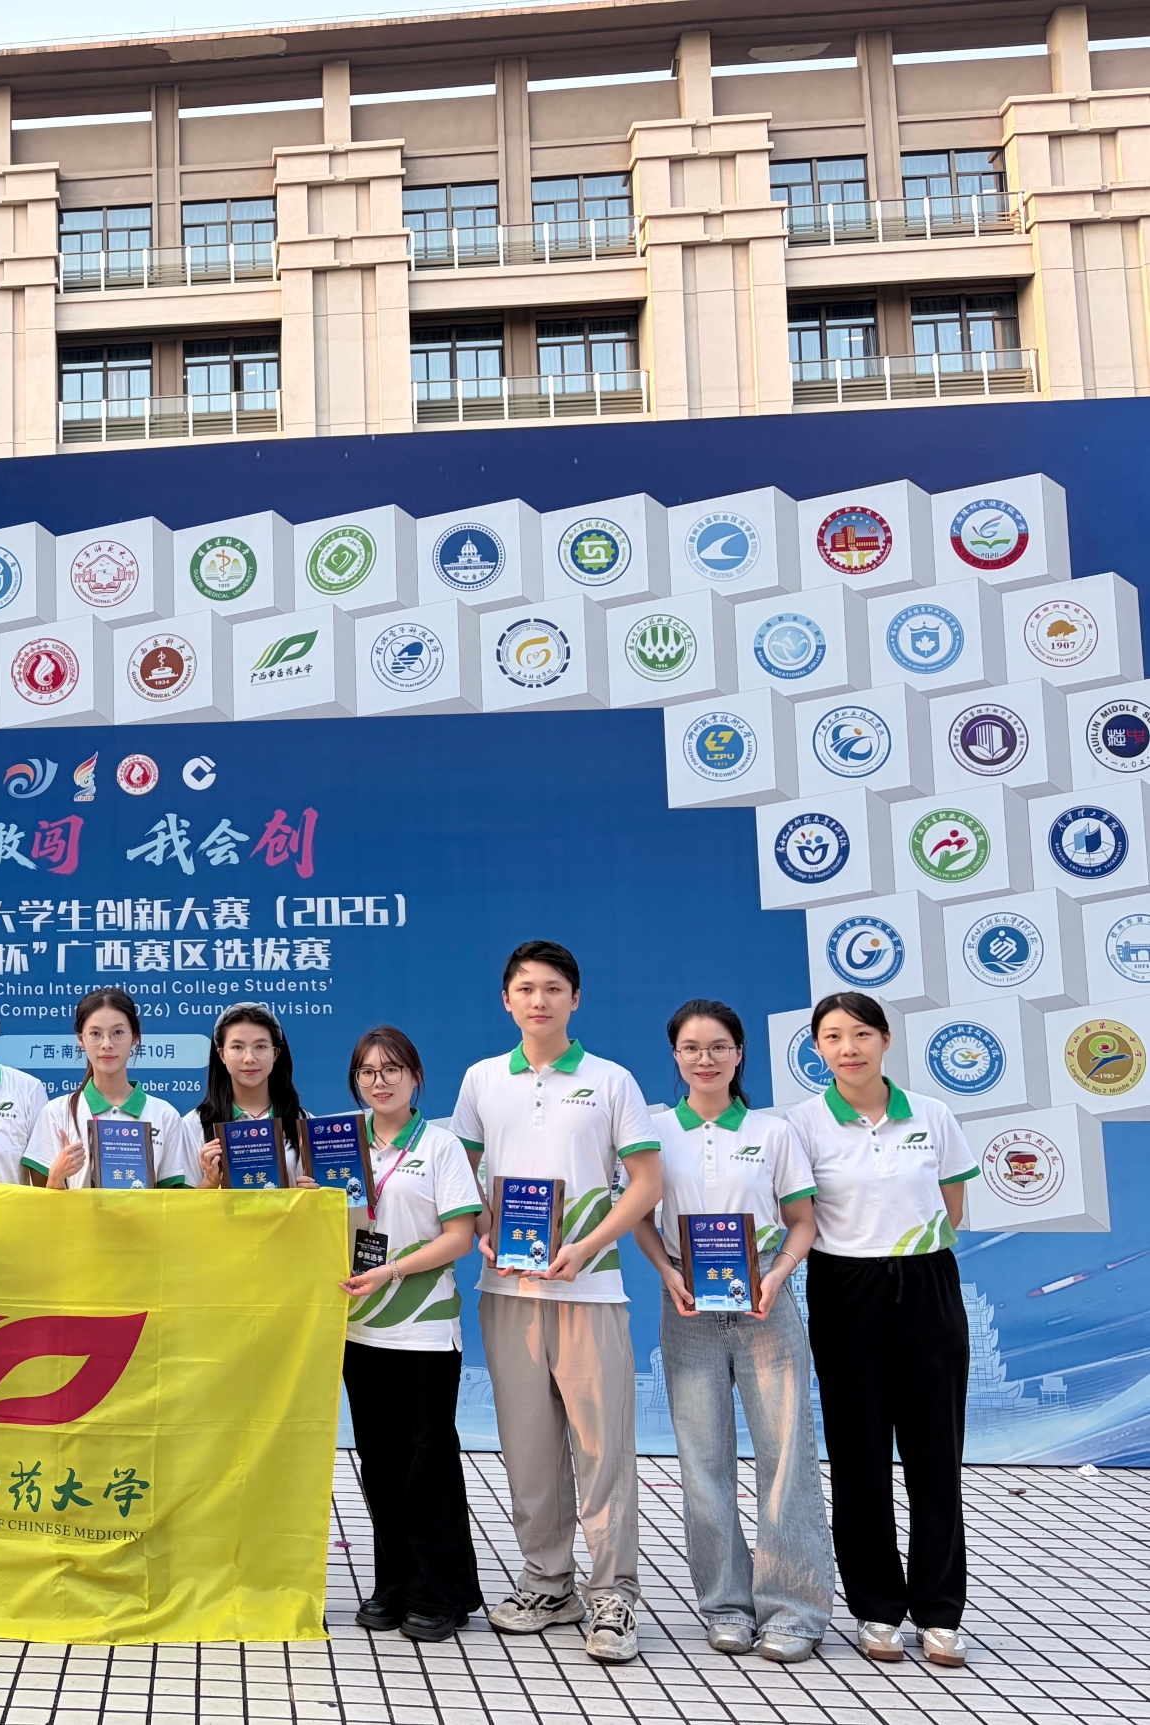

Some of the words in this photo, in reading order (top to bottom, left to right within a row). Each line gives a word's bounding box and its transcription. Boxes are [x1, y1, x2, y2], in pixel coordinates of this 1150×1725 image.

[688, 514, 756, 543] 柳州铁道职业技术学院
[952, 501, 1027, 534] 广西隆林民族高级中学
[193, 569, 202, 588] GUILIN
[204, 588, 229, 599] MEDICAL
[233, 566, 254, 596] UNIVERSITY
[758, 615, 821, 640] 北海职业学院
[1030, 604, 1093, 630] 广西柳州高级中学
[132, 637, 194, 669] 广西医科大学
[1050, 641, 1076, 649] 1907
[250, 663, 313, 683] 广西中医药大学
[757, 650, 769, 668] BEIHAI
[771, 669, 807, 677] VOCATIONAL
[808, 648, 823, 670] COLLEGE
[132, 671, 146, 693] GUANGXI
[146, 690, 171, 698] MEDICAL
[171, 665, 192, 694] UNIVERSITY
[1091, 720, 1102, 754] GUILIN
[1100, 704, 1139, 719] MIDDLE
[687, 742, 699, 766] LIUZHOU
[698, 765, 738, 777] POLYTECHNIC
[737, 740, 753, 771] UNIVERSITY
[706, 753, 735, 761] LZPU
[915, 813, 985, 844] 广西卫生职业技术学院
[126, 807, 318, 878] 我会创
[915, 849, 930, 869] GUANGXI
[930, 868, 950, 878] HEALTH
[952, 869, 972, 877] SCIENCE
[972, 849, 986, 869] COLLEGE
[1054, 842, 1067, 864] NANNING
[1068, 863, 1092, 874] COLLEGE
[1104, 841, 1123, 869] TECHNOLOGY
[829, 919, 902, 952] 广西机电职业技术学院
[1110, 954, 1128, 974] Qinzhou
[171, 980, 240, 995] College
[244, 977, 333, 992] Students'
[1, 1003, 77, 1019] Competi
[135, 1003, 170, 1018] 026)
[178, 1001, 231, 1015] Guan
[1068, 1022, 1143, 1058] 灵山县第二中学
[172, 1080, 201, 1092] 2026
[793, 1069, 812, 1088] TRANSPORT
[1070, 1064, 1090, 1088] Lingshan
[1091, 1085, 1107, 1094] No.2
[1109, 1083, 1130, 1094] Middle
[1129, 1063, 1142, 1084] School
[986, 1132, 1060, 1166] 桂林信息科技学院
[112, 1168, 135, 1180] 金奖
[242, 1171, 267, 1185] 金奖
[326, 1167, 351, 1180] 金奖
[512, 1228, 538, 1241] 金奖
[706, 1267, 734, 1280] 金奖
[8, 1519, 71, 1537] CHINESE
